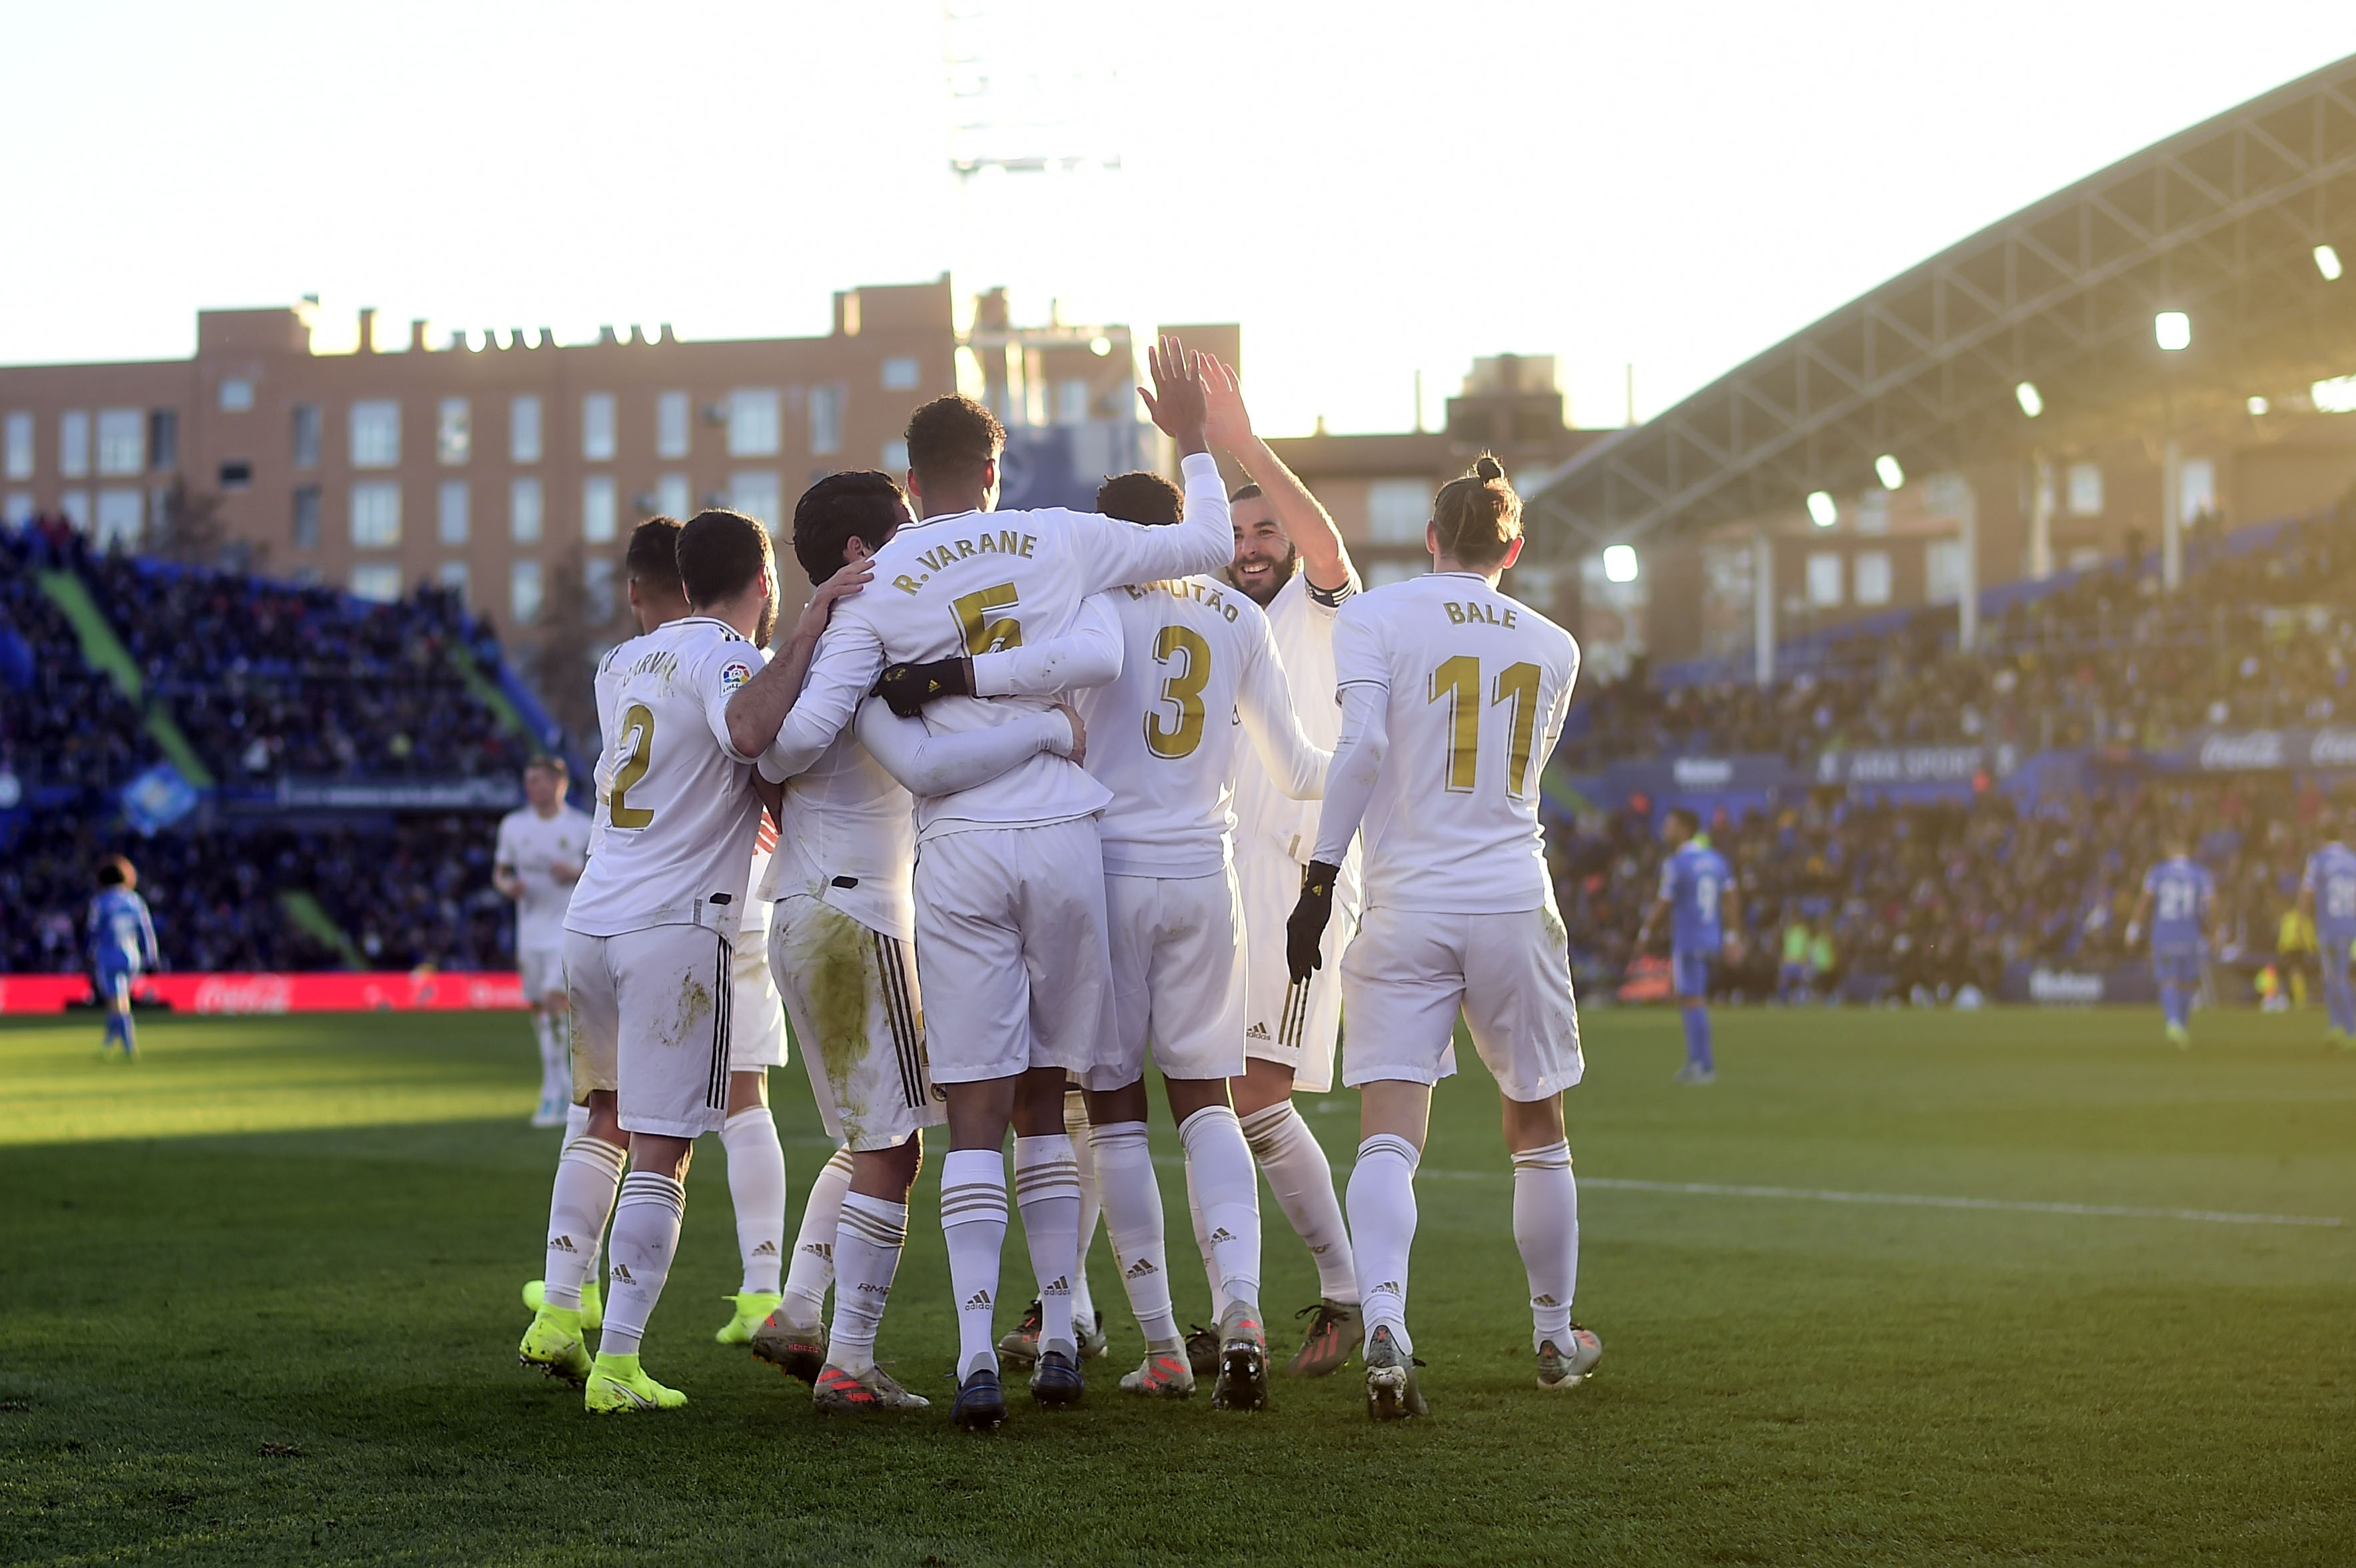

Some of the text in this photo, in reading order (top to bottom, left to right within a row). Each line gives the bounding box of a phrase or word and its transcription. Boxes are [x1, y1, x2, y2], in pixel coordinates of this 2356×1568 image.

[948, 582, 1022, 657] 5
[1123, 579, 1238, 623] E.ILITÃO
[1443, 601, 1517, 630] BALE
[1142, 625, 1211, 759] 3
[1428, 655, 1541, 801] 11
[610, 704, 655, 831] 2
[1125, 1266, 1159, 1280] adidas
[964, 1302, 993, 1311] adidas
